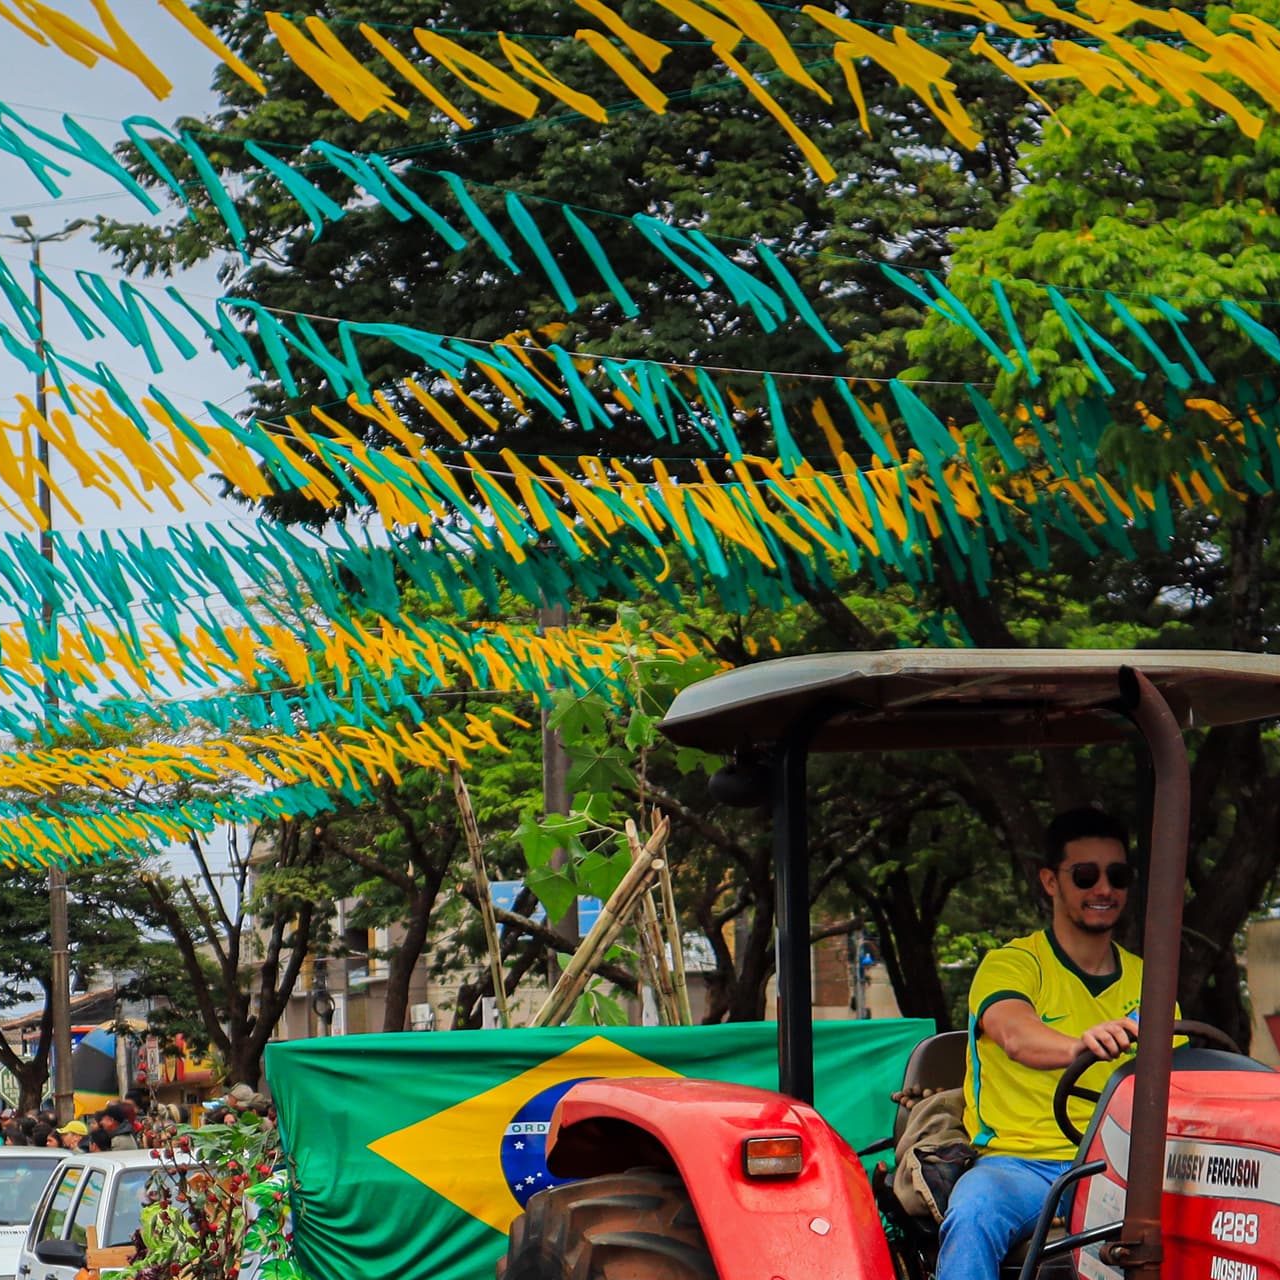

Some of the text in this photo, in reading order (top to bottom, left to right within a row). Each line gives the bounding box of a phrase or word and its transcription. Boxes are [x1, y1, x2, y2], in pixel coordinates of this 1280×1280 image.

[511, 1123, 546, 1133] ORD
[1166, 1153, 1261, 1189] MASSEY FERGUSON
[1210, 1211, 1259, 1245] 4283
